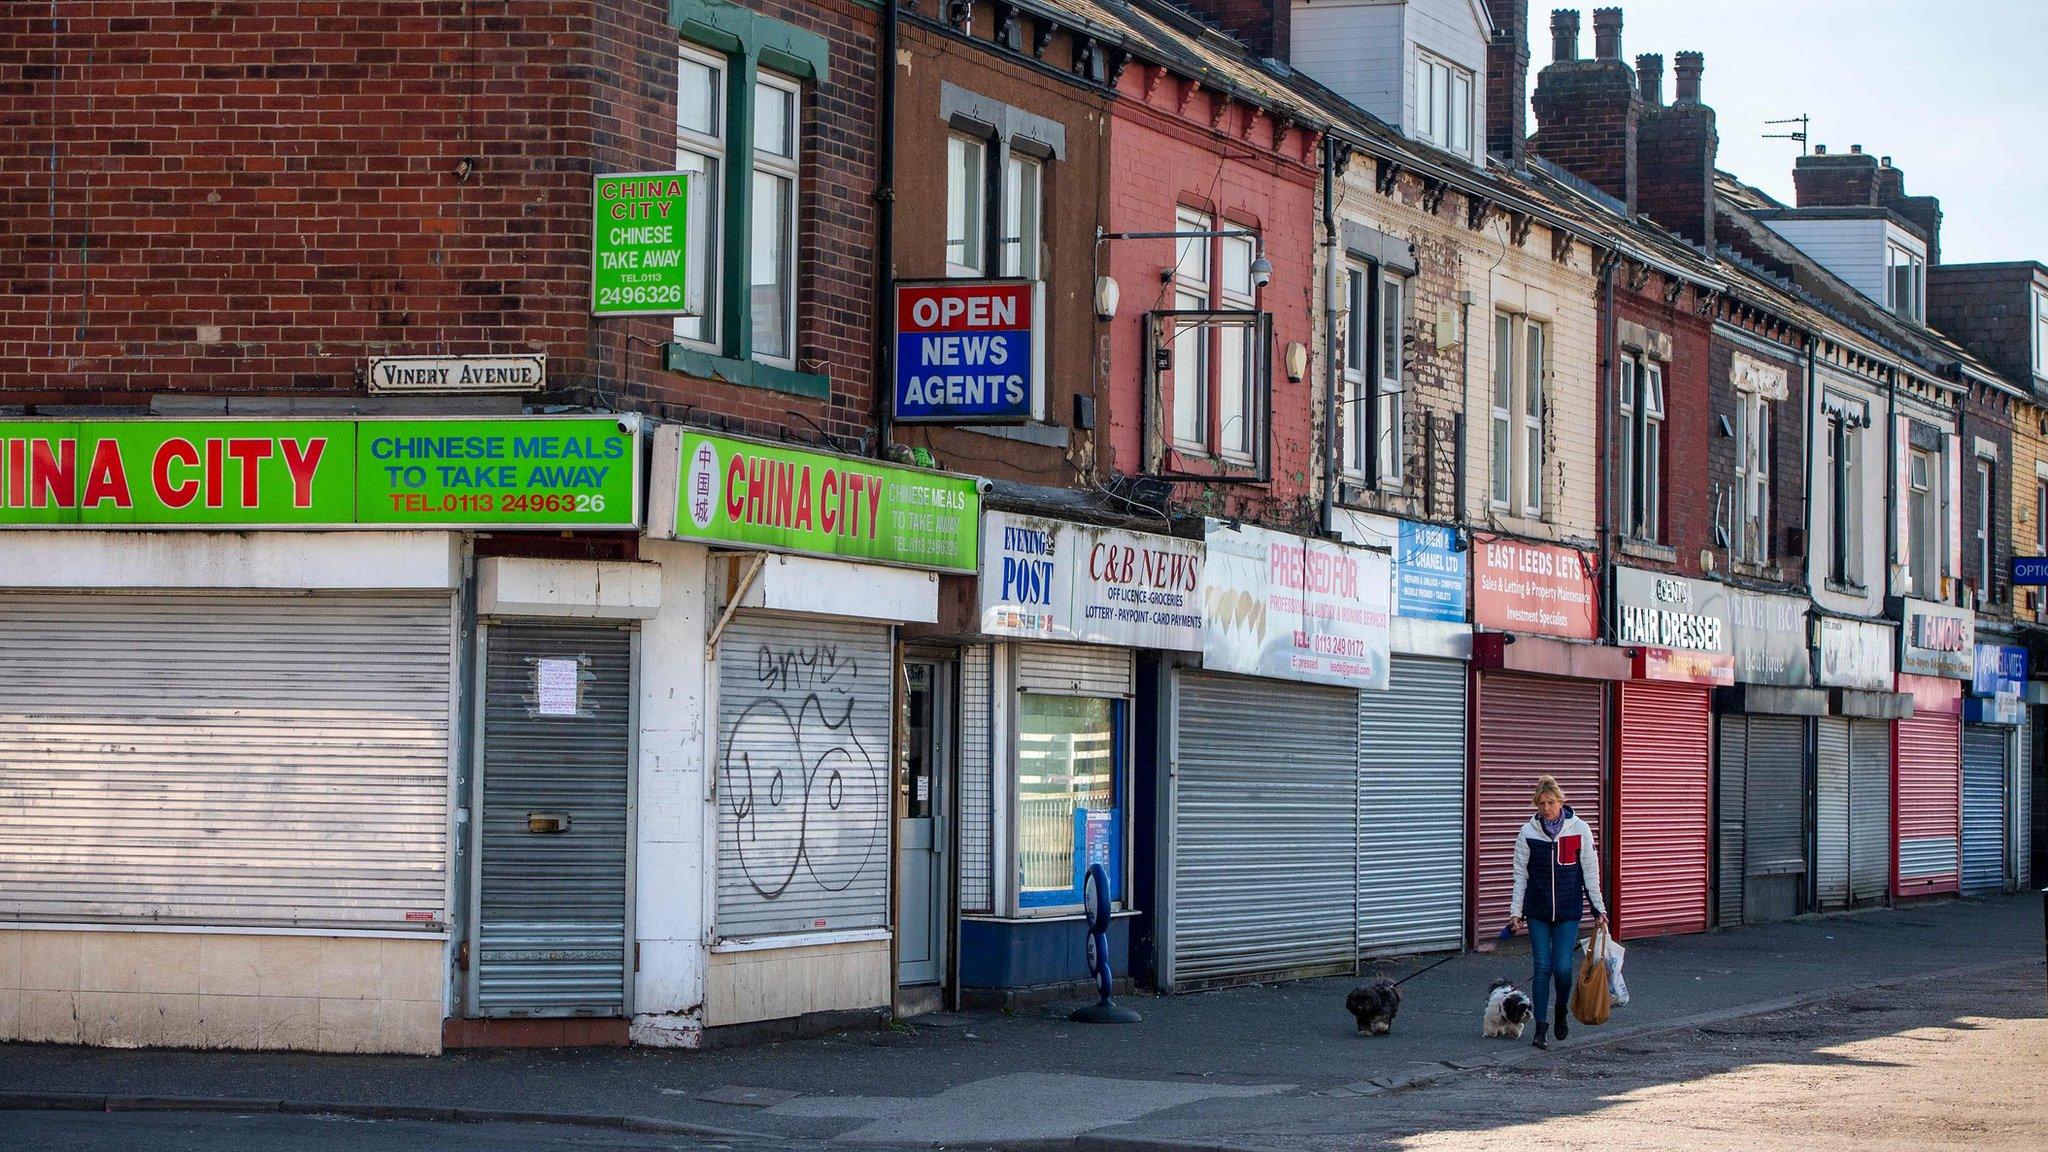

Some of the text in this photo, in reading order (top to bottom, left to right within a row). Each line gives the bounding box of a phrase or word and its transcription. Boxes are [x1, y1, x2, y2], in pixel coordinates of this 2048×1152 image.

[601, 179, 682, 199] CHINA
[611, 201, 673, 220] CITY
[609, 226, 673, 246] CHINESE
[601, 249, 681, 271] TAKE AWAY
[620, 273, 662, 284] TEL.0113
[600, 284, 682, 305] 2496326
[912, 296, 1017, 327] OPEN
[921, 336, 1008, 366] NEWS
[904, 374, 1025, 405] AGENTS
[371, 436, 625, 461] CHINESE MEALS
[0, 437, 328, 510] INA CITY
[386, 465, 611, 489] TO TAKE AWAY
[695, 445, 711, 523] 中国城
[391, 494, 606, 514] TEL.0113 2496326
[725, 453, 883, 540] CHINA CITY
[889, 482, 965, 511] CHINESE MEALS
[892, 510, 960, 535] TO TAKE AWAY
[1003, 526, 1047, 556] EVENING
[1089, 542, 1199, 592] C&B NEWS
[1270, 543, 1331, 594] PRESSED
[1487, 544, 1581, 581] EAST LEEDS LETS
[1001, 556, 1054, 605] POST
[1482, 574, 1591, 604] Sales & Letting & Property Maintenance
[1108, 587, 1121, 600] OFF
[1121, 588, 1148, 604] LICENCE
[1085, 605, 1114, 621] LOTTERY
[1117, 608, 1149, 624] PAYPOINT
[1152, 610, 1171, 626] CARD
[1171, 612, 1202, 629] PAYMENTS
[1506, 605, 1568, 627] Investment Specialists
[1623, 605, 1722, 651] HAIR DRESSER
[1314, 634, 1332, 653] 0113
[1332, 636, 1346, 656] 249
[1347, 638, 1365, 658] 0172
[1744, 647, 1785, 680] Boutique
